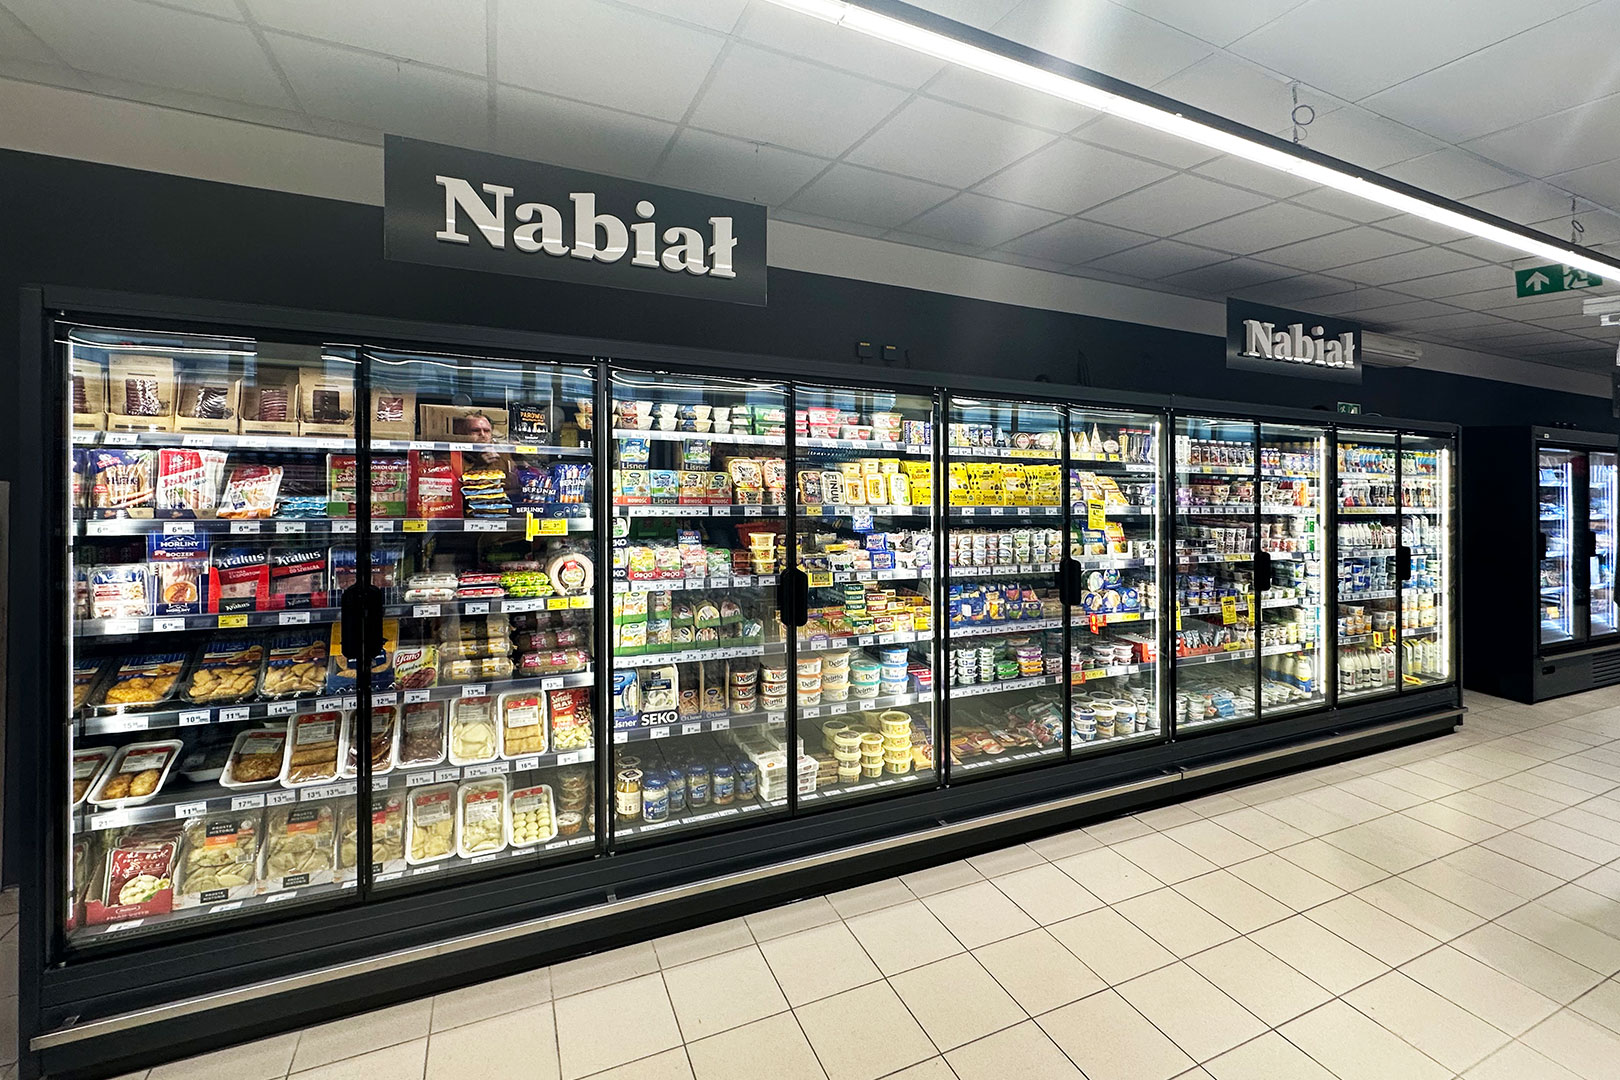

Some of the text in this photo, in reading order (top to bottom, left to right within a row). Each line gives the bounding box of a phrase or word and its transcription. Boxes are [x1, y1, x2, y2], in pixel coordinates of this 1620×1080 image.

[435, 175, 738, 279] Nabiał
[1243, 319, 1355, 369] Nabiał
[621, 462, 647, 470] Lisner
[685, 463, 709, 471] Lisner
[522, 487, 557, 495] BERLINKI
[829, 474, 839, 503] FINUU
[216, 553, 265, 568] Krakus
[275, 551, 321, 565] Krakus
[633, 571, 653, 579] dega
[661, 570, 680, 579] dega
[553, 700, 573, 709] MAK
[641, 711, 678, 726] SEKO
